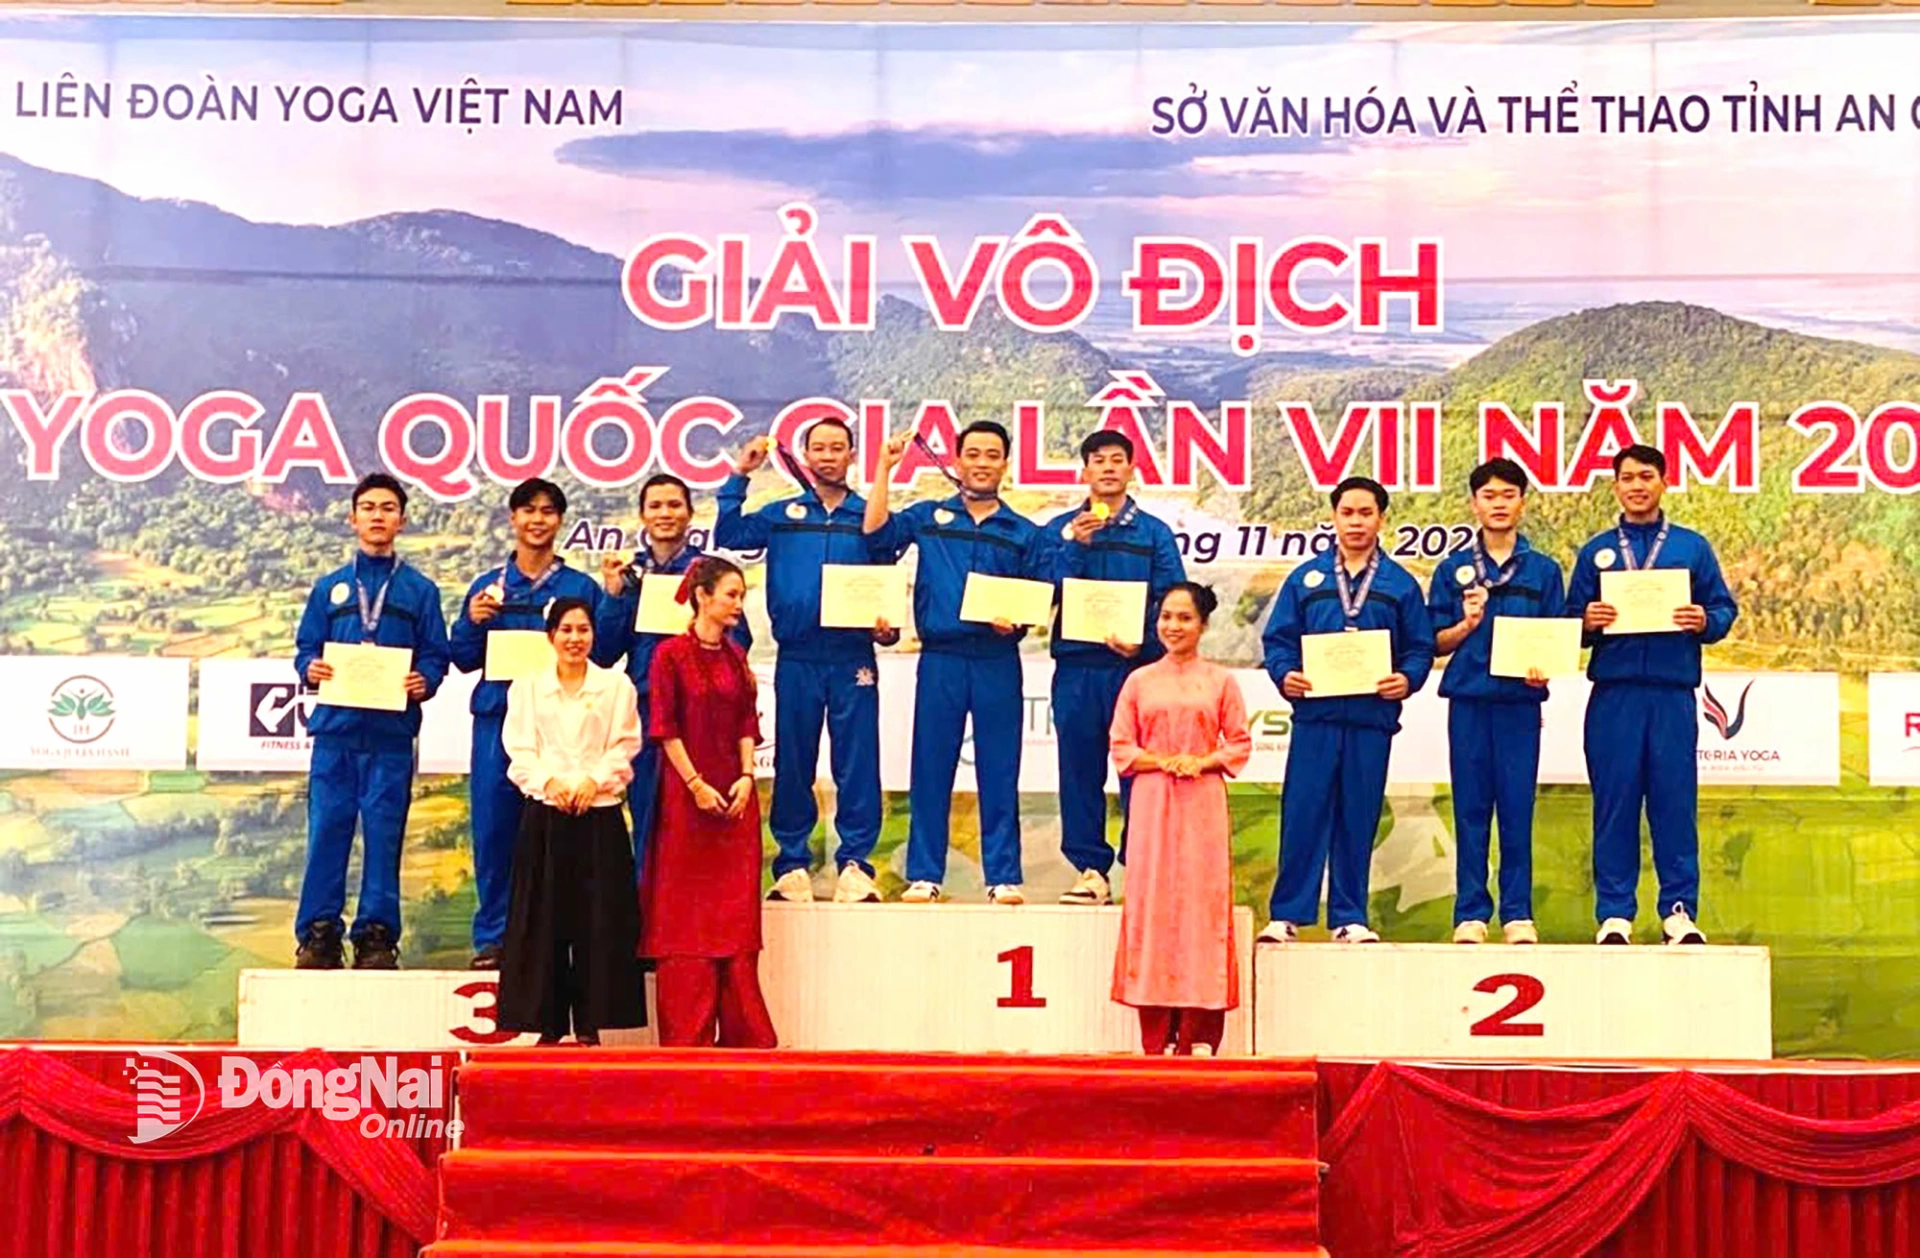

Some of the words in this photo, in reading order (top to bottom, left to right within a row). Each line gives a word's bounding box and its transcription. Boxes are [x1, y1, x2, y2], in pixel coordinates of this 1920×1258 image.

[17, 72, 110, 118] LIÊN
[127, 75, 257, 120] ĐOÀN
[274, 85, 398, 123] YOGA
[413, 78, 509, 133] VIỆT
[524, 89, 622, 125] NAM
[1152, 82, 1207, 134] SỞ
[1220, 86, 1308, 134] VĂN
[1324, 86, 1417, 134] HÓA
[1427, 86, 1487, 134] VÀ
[1498, 80, 1579, 133] THỂ
[1591, 94, 1710, 133] THAO
[1722, 81, 1821, 132] TỈNH
[1835, 94, 1895, 132] AN
[625, 205, 874, 328] GIẢI
[905, 215, 1095, 329] VÔ
[1126, 239, 1440, 353] ĐỊCH
[9, 391, 352, 481] YOGA
[381, 368, 741, 497] QUỐC
[1282, 403, 1439, 488] VII
[1481, 382, 1756, 489] NĂM
[564, 520, 624, 551] An
[1237, 526, 1268, 556] 11
[1281, 525, 1337, 556] nă
[1394, 526, 1474, 556] 202
[261, 740, 301, 750] FITNESS
[1740, 749, 1781, 761] YOGA
[996, 945, 1048, 1008] 1
[1470, 973, 1546, 1037] 2
[448, 981, 522, 1045] 3
